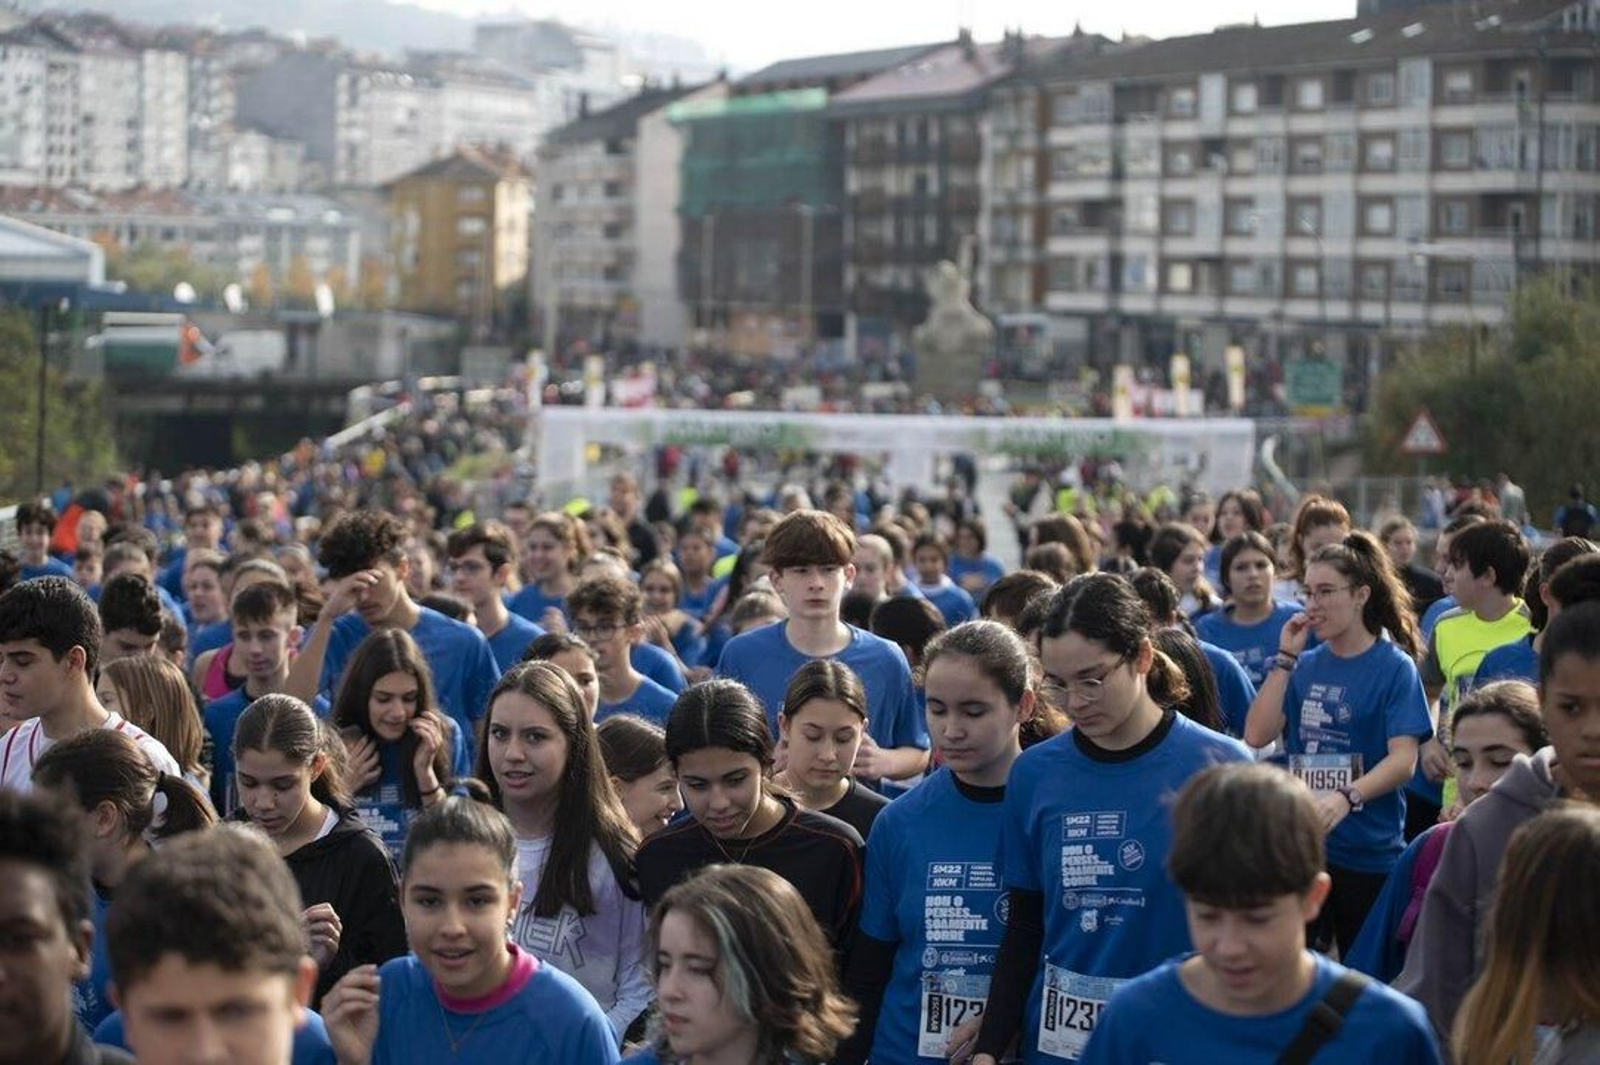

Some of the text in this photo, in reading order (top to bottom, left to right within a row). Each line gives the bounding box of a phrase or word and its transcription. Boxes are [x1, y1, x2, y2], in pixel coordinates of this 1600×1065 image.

[1062, 844, 1094, 856] NON O
[932, 865, 962, 874] SM22
[1062, 864, 1115, 876] SOAMENTE
[1062, 875, 1098, 887] CORRE
[925, 895, 964, 907] NON O
[925, 918, 988, 931] SOAMENTE
[926, 930, 965, 941] CORRE
[1059, 996, 1105, 1031] 123
